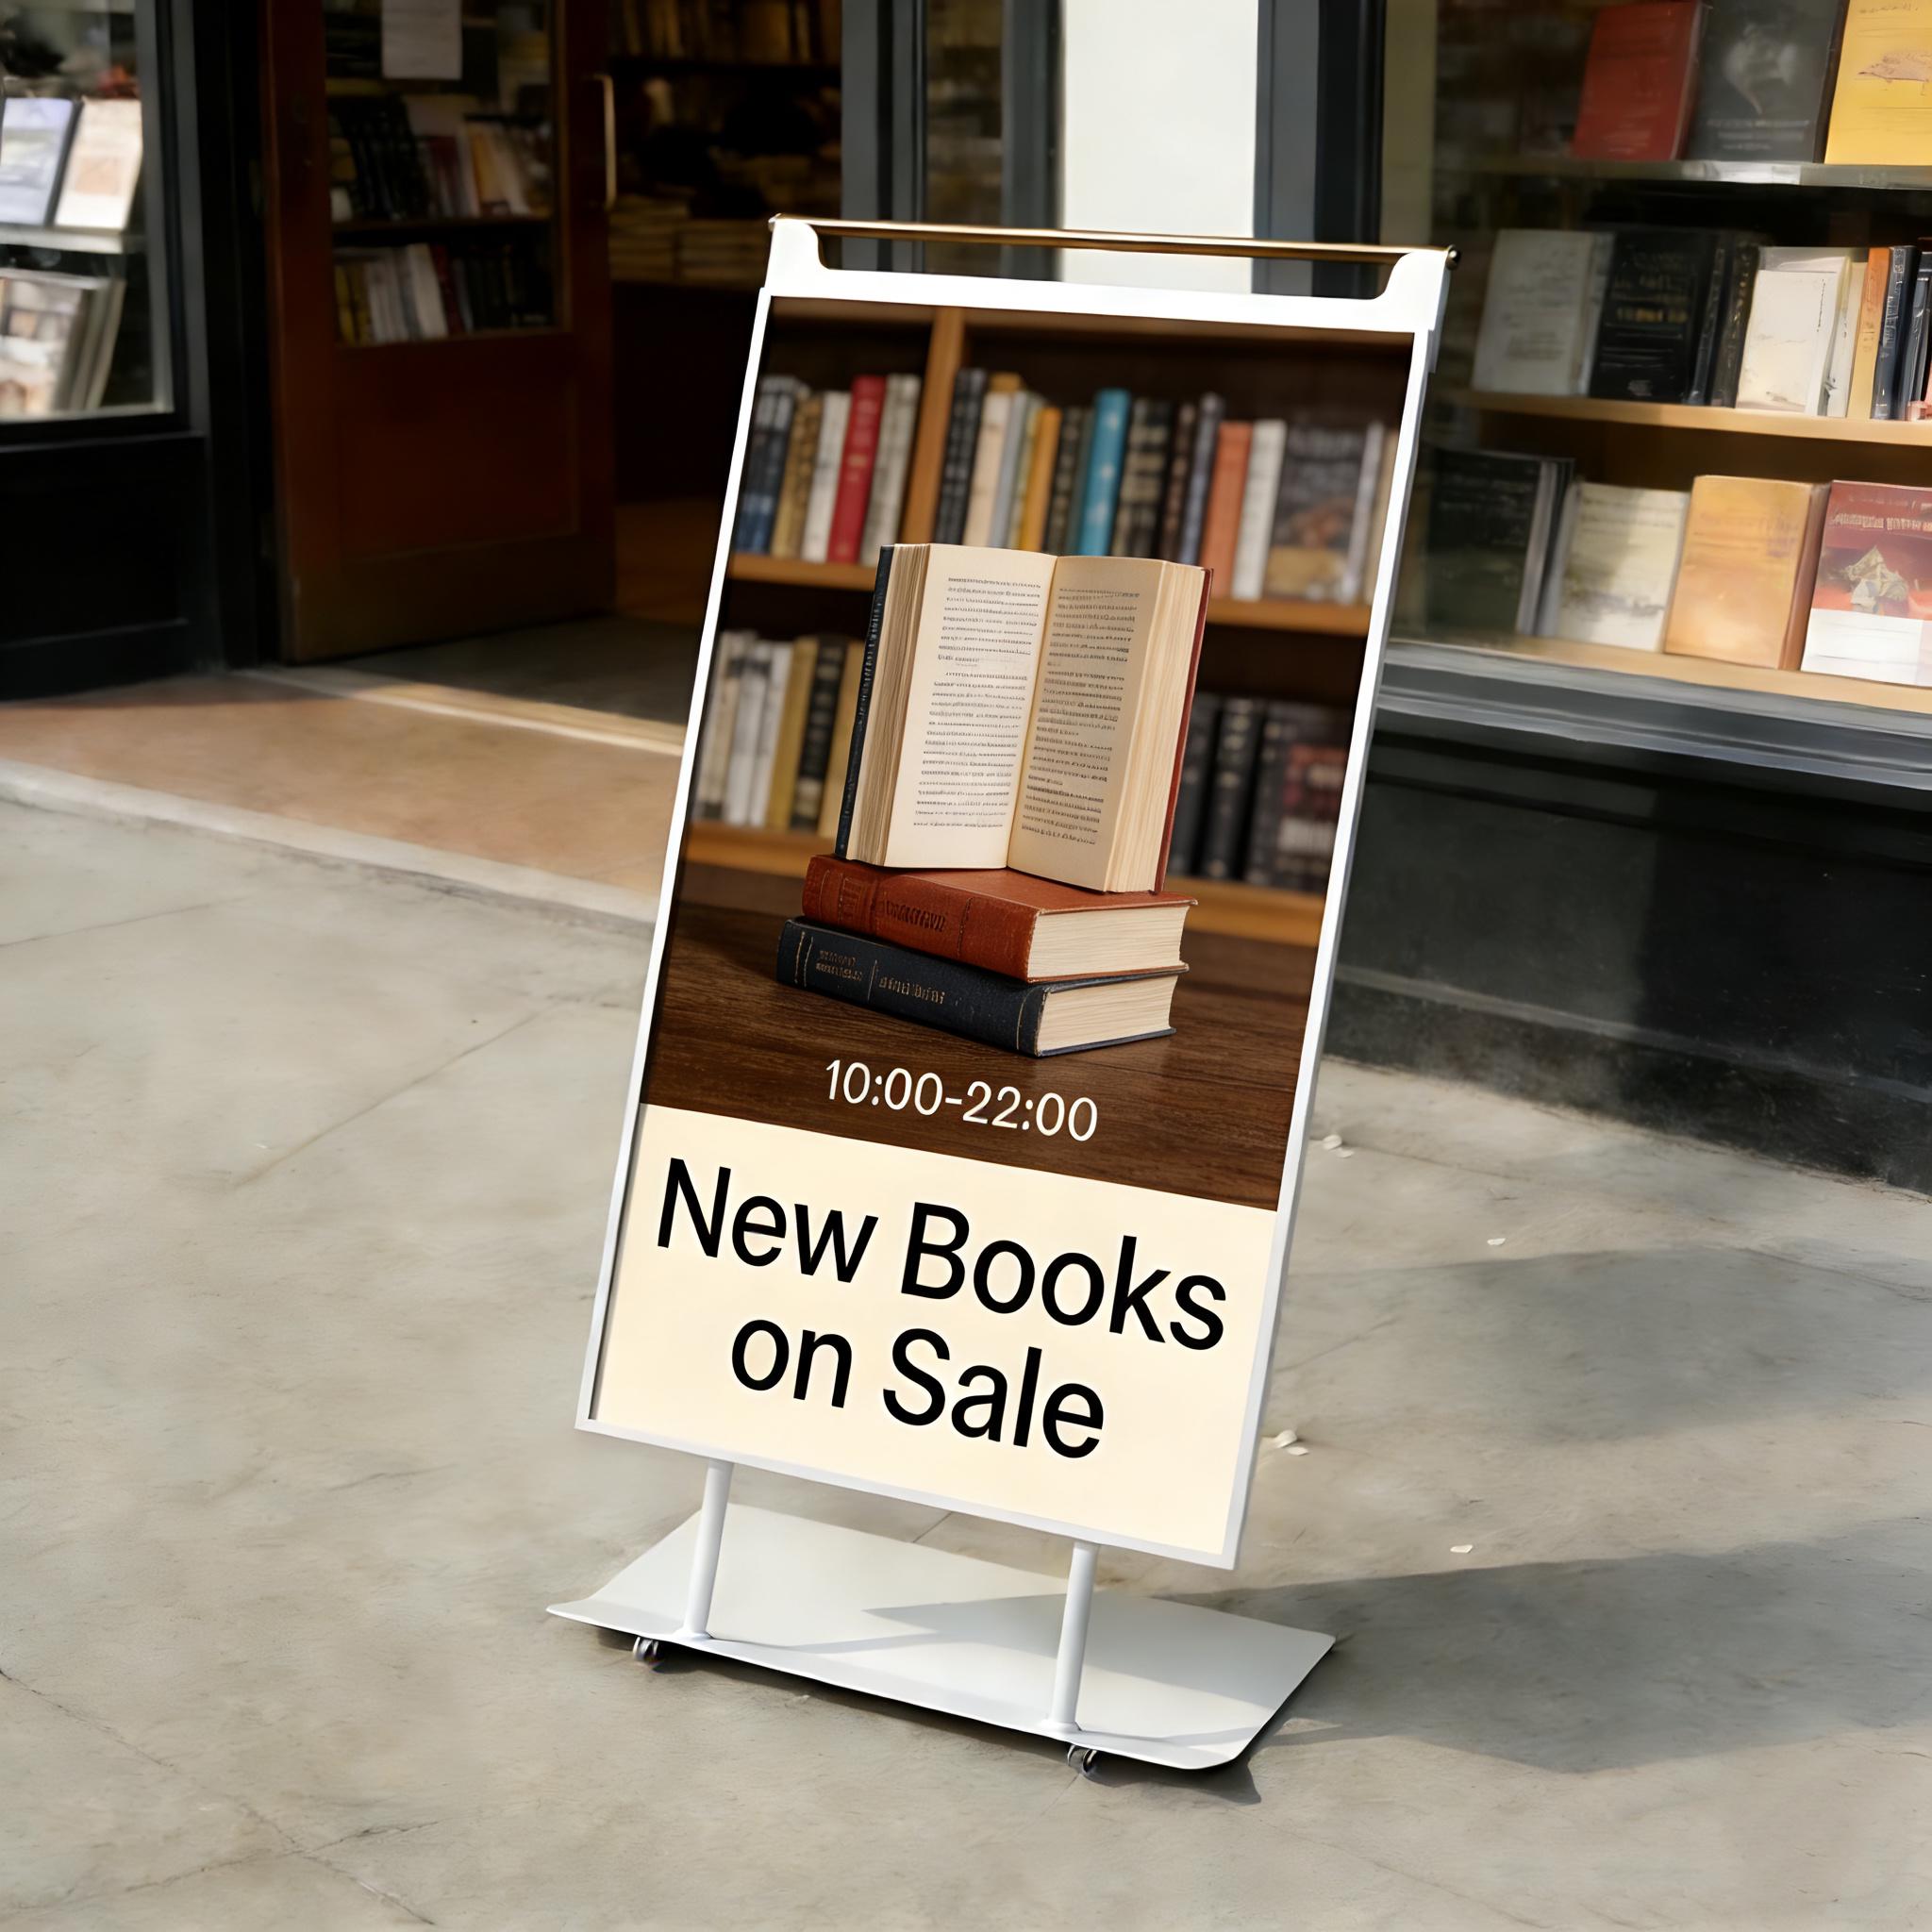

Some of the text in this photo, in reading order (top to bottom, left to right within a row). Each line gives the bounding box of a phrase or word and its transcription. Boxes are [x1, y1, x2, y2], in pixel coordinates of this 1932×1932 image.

[825, 1059, 1098, 1141] 10:00-22:00
[658, 1158, 1226, 1351] New Books
[732, 1319, 1105, 1458] on Sale
